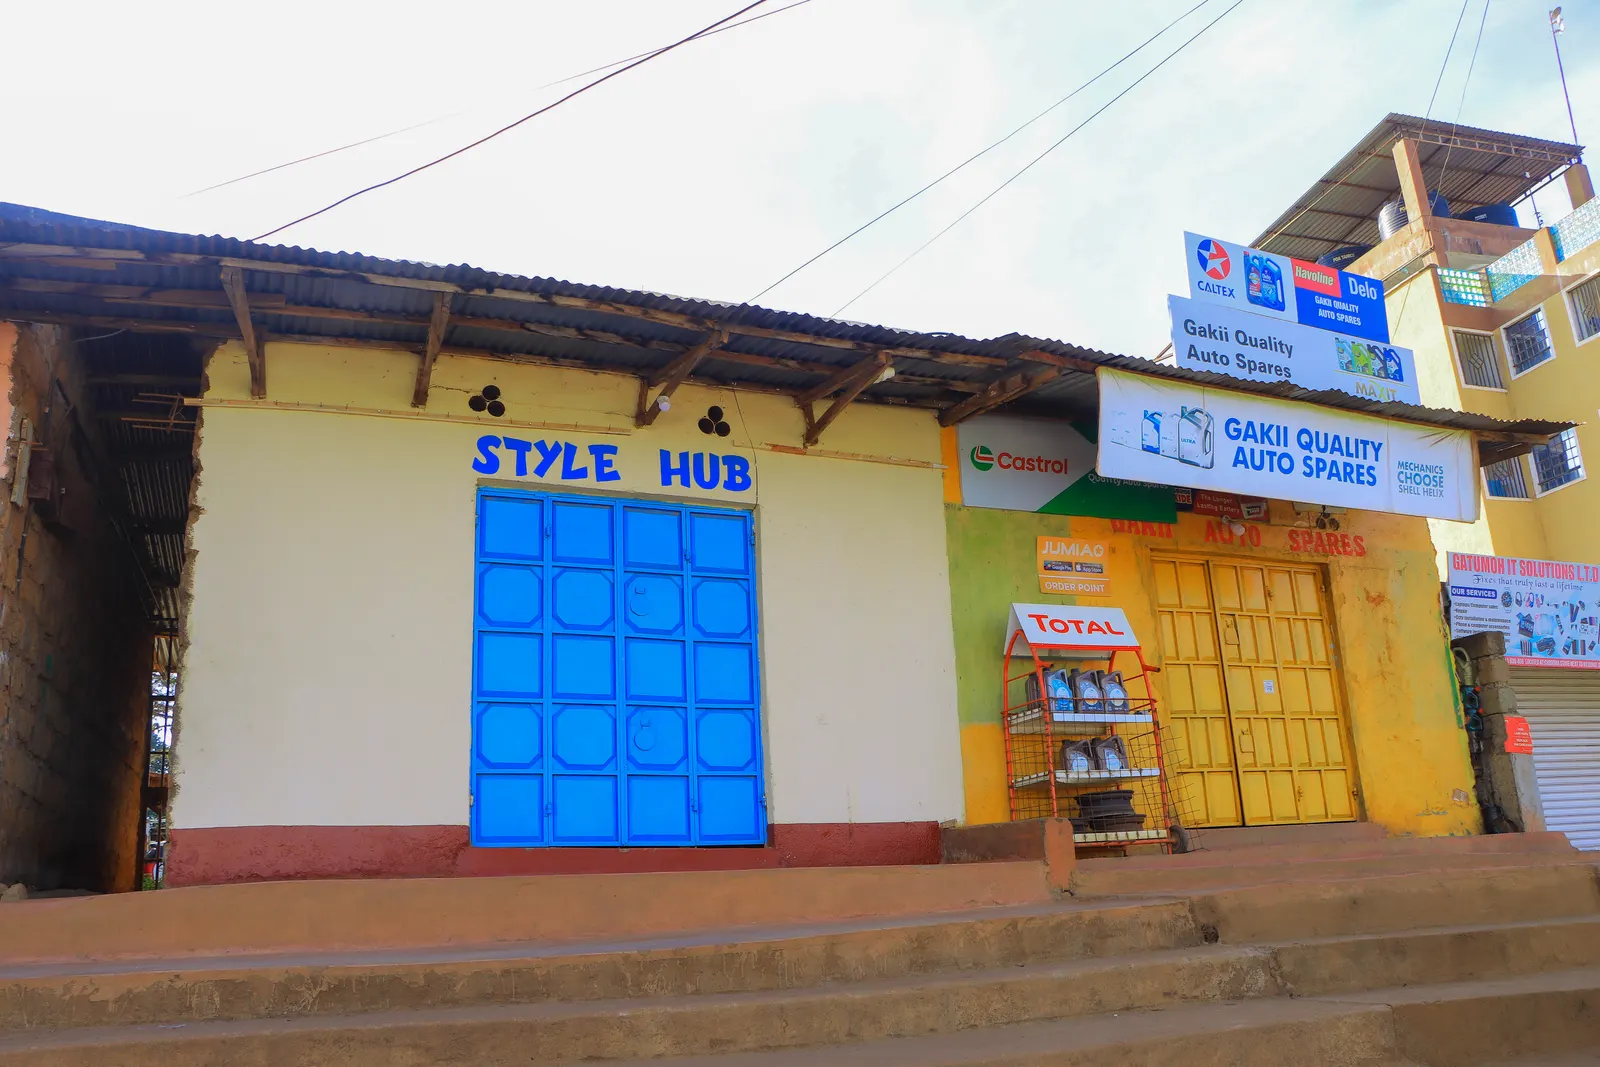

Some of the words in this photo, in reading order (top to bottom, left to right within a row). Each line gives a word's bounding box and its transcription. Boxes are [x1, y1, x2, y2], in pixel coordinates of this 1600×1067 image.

[1295, 265, 1334, 286] Havoline
[1197, 280, 1235, 299] CALTEX
[1348, 276, 1377, 300] Delo
[1315, 295, 1332, 307] GAKII
[1333, 300, 1359, 313] QUALITY
[1318, 308, 1335, 320] AUTO
[1336, 312, 1361, 326] SPARES
[1183, 319, 1229, 343] Gakii
[1234, 329, 1293, 359] Quality
[1187, 344, 1230, 366] Auto
[1235, 353, 1292, 378] Spares
[1355, 380, 1397, 402] MAXIT
[1225, 417, 1288, 448] GAKII
[1296, 428, 1383, 462] QUALITY
[471, 434, 621, 483] STYLE
[659, 448, 752, 492] HUB
[997, 452, 1068, 475] Castrol
[1232, 446, 1295, 475] AUTO
[1302, 455, 1377, 487] SPARES
[1397, 460, 1444, 475] MECHANICS
[1397, 471, 1444, 488] CHOOSE
[1398, 484, 1421, 496] SHELL
[1422, 487, 1444, 498] HELIX
[1204, 520, 1261, 547] AUTO
[1288, 529, 1366, 557] SPARES
[1453, 553, 1505, 574] GATUMOH
[1507, 559, 1517, 575] IT
[1520, 560, 1575, 580] SOLUTIONS
[1045, 581, 1076, 591] ORDER
[1078, 584, 1105, 592] POINT
[1466, 589, 1496, 597] SERVICES
[1473, 574, 1496, 585] Fixes
[1499, 576, 1513, 585] that
[1515, 579, 1533, 590] truly
[1535, 579, 1548, 588] last
[1556, 581, 1583, 592] lifetime
[1028, 613, 1125, 636] TOTAL
